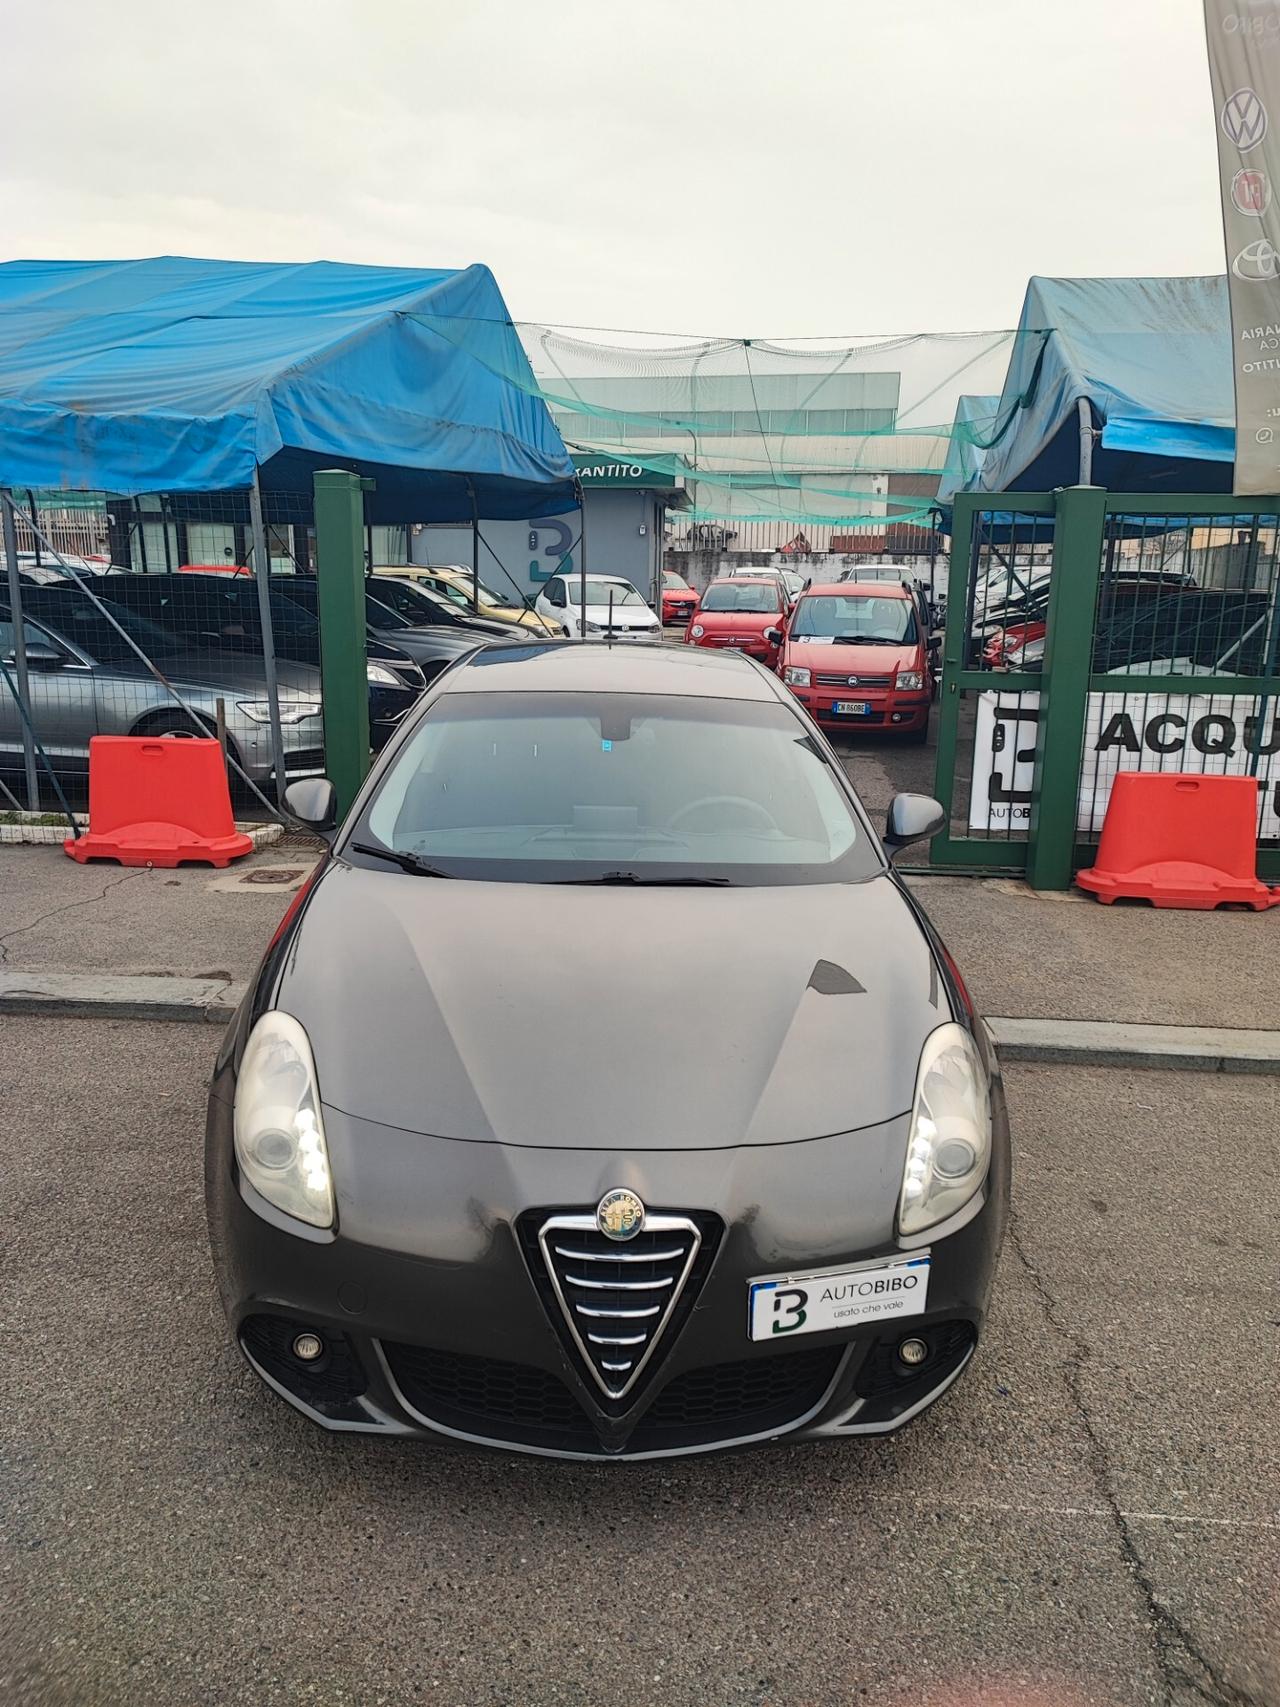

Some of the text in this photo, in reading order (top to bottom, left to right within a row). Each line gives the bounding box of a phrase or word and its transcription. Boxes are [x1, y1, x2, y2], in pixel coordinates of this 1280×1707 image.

[820, 1275, 918, 1303] AUTOBIBO
[833, 1300, 904, 1319] usato che vale
